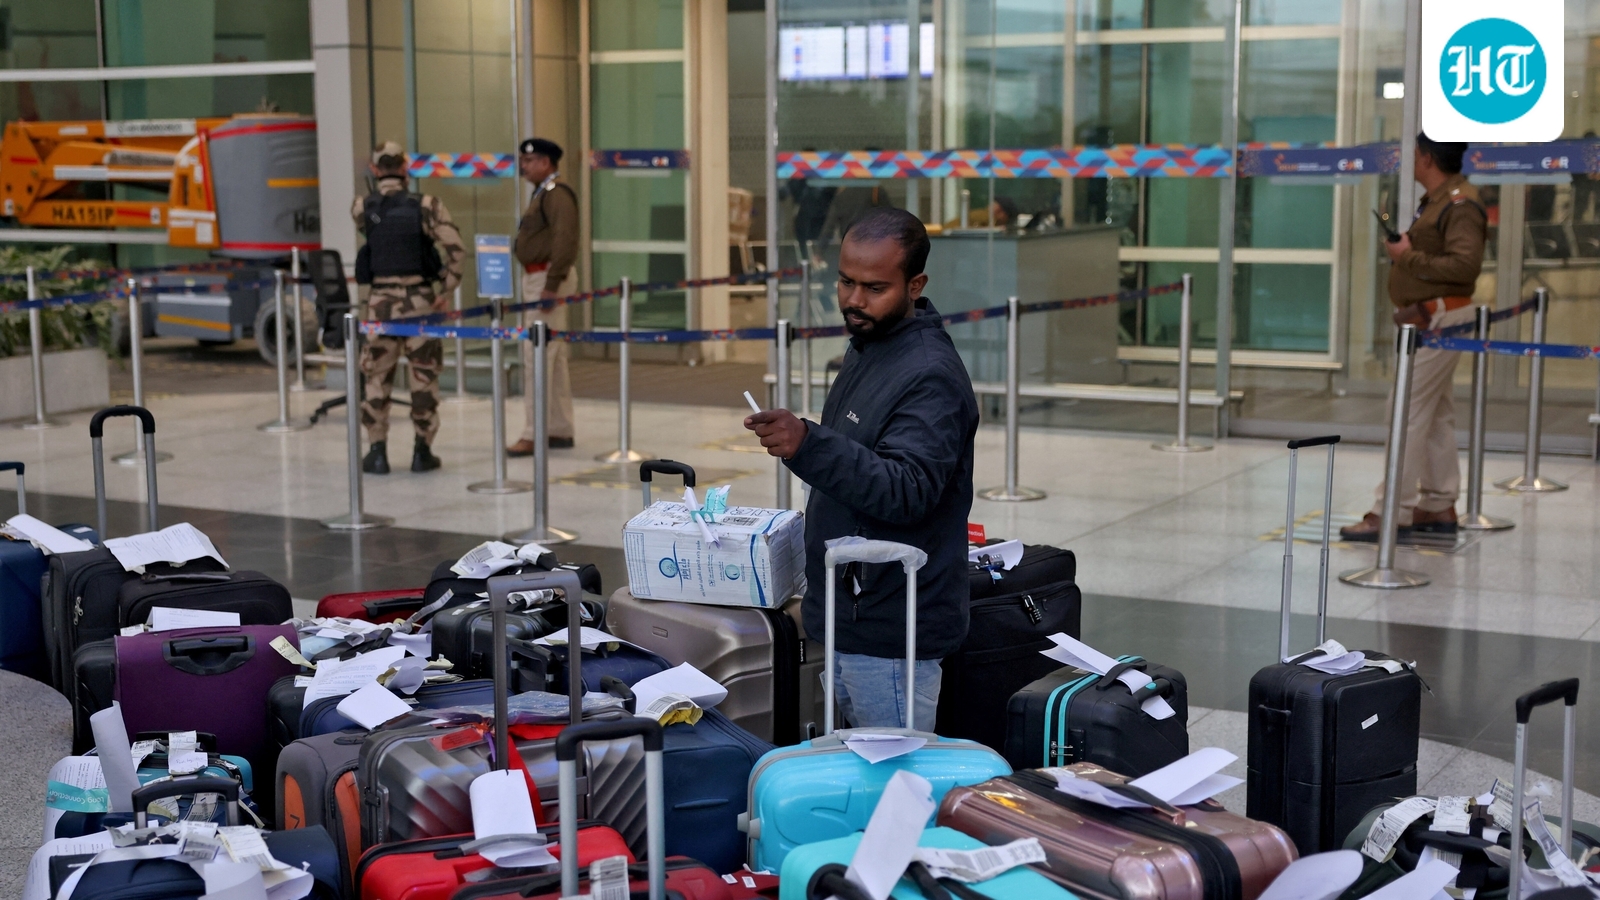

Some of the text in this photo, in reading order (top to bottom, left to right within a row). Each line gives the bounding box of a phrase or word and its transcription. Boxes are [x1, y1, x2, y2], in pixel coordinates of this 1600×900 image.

[52, 207, 115, 222] HA15IP
[49, 790, 105, 805] Long Connection
